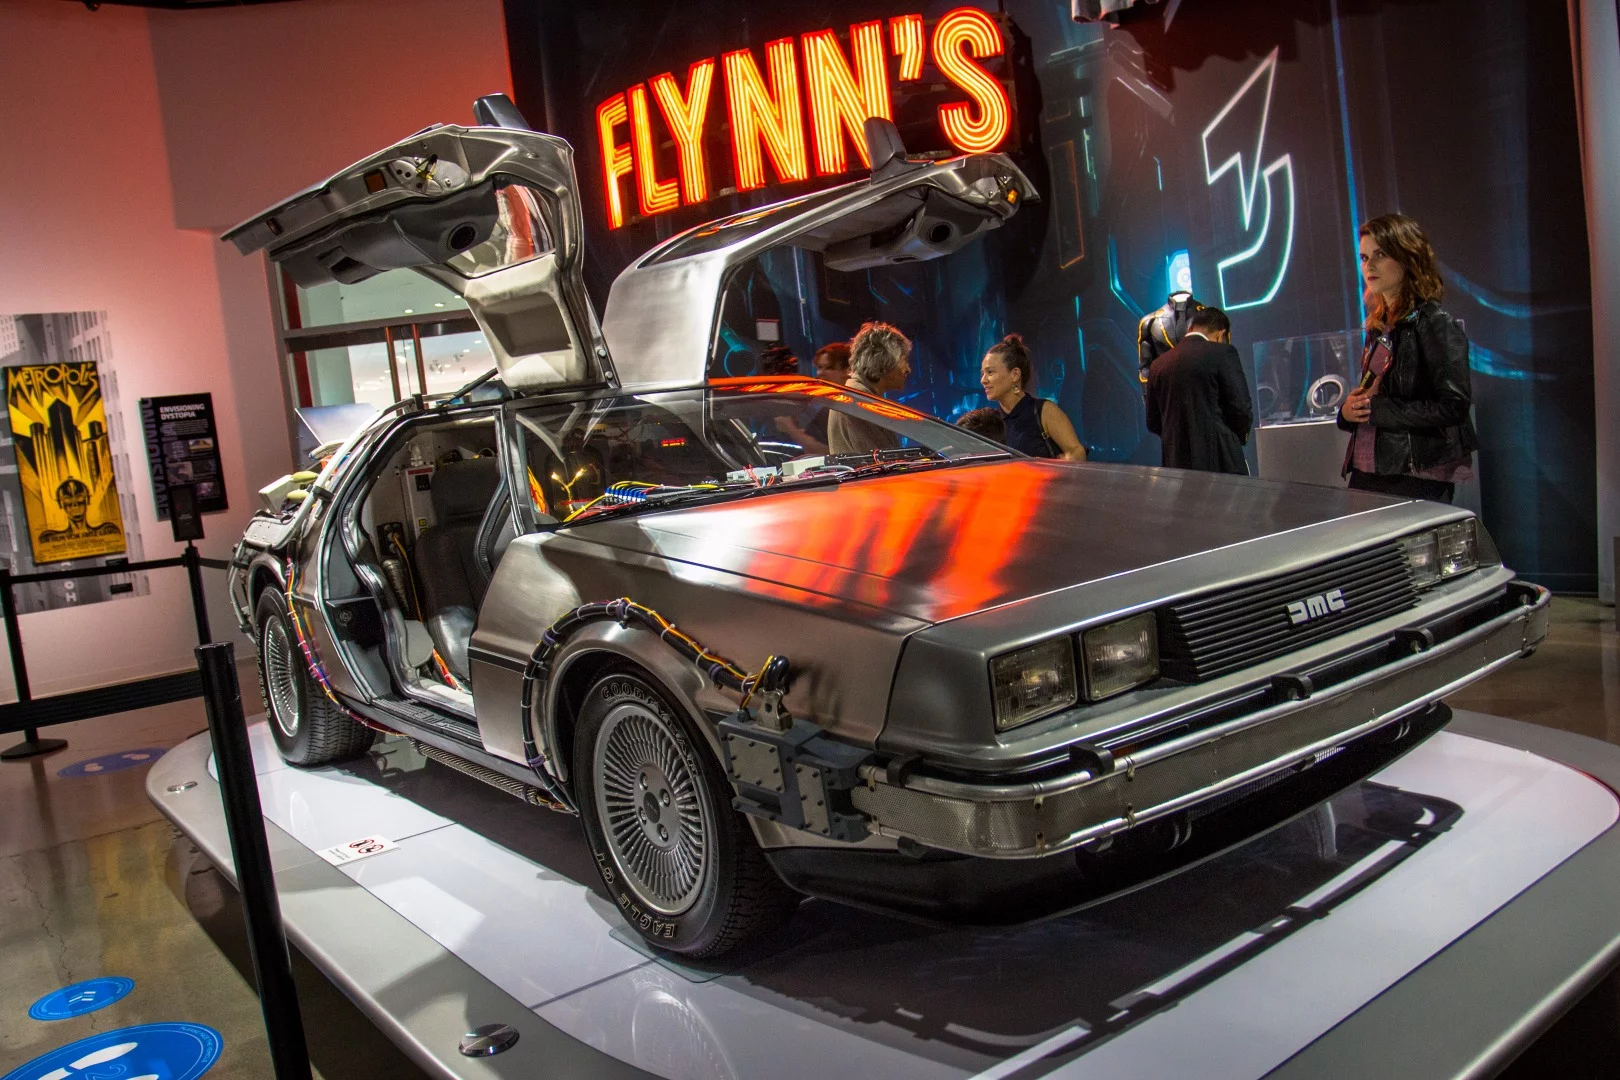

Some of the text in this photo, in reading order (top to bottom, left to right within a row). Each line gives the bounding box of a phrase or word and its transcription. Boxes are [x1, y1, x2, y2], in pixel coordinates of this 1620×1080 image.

[596, 7, 1012, 230] FLYNN'S
[8, 363, 98, 405] METROPOLIS
[160, 403, 205, 413] ENVISIONING
[161, 411, 196, 420] DYSTOPIA
[1288, 589, 1345, 624] DMC
[618, 893, 675, 938] EAGLE
